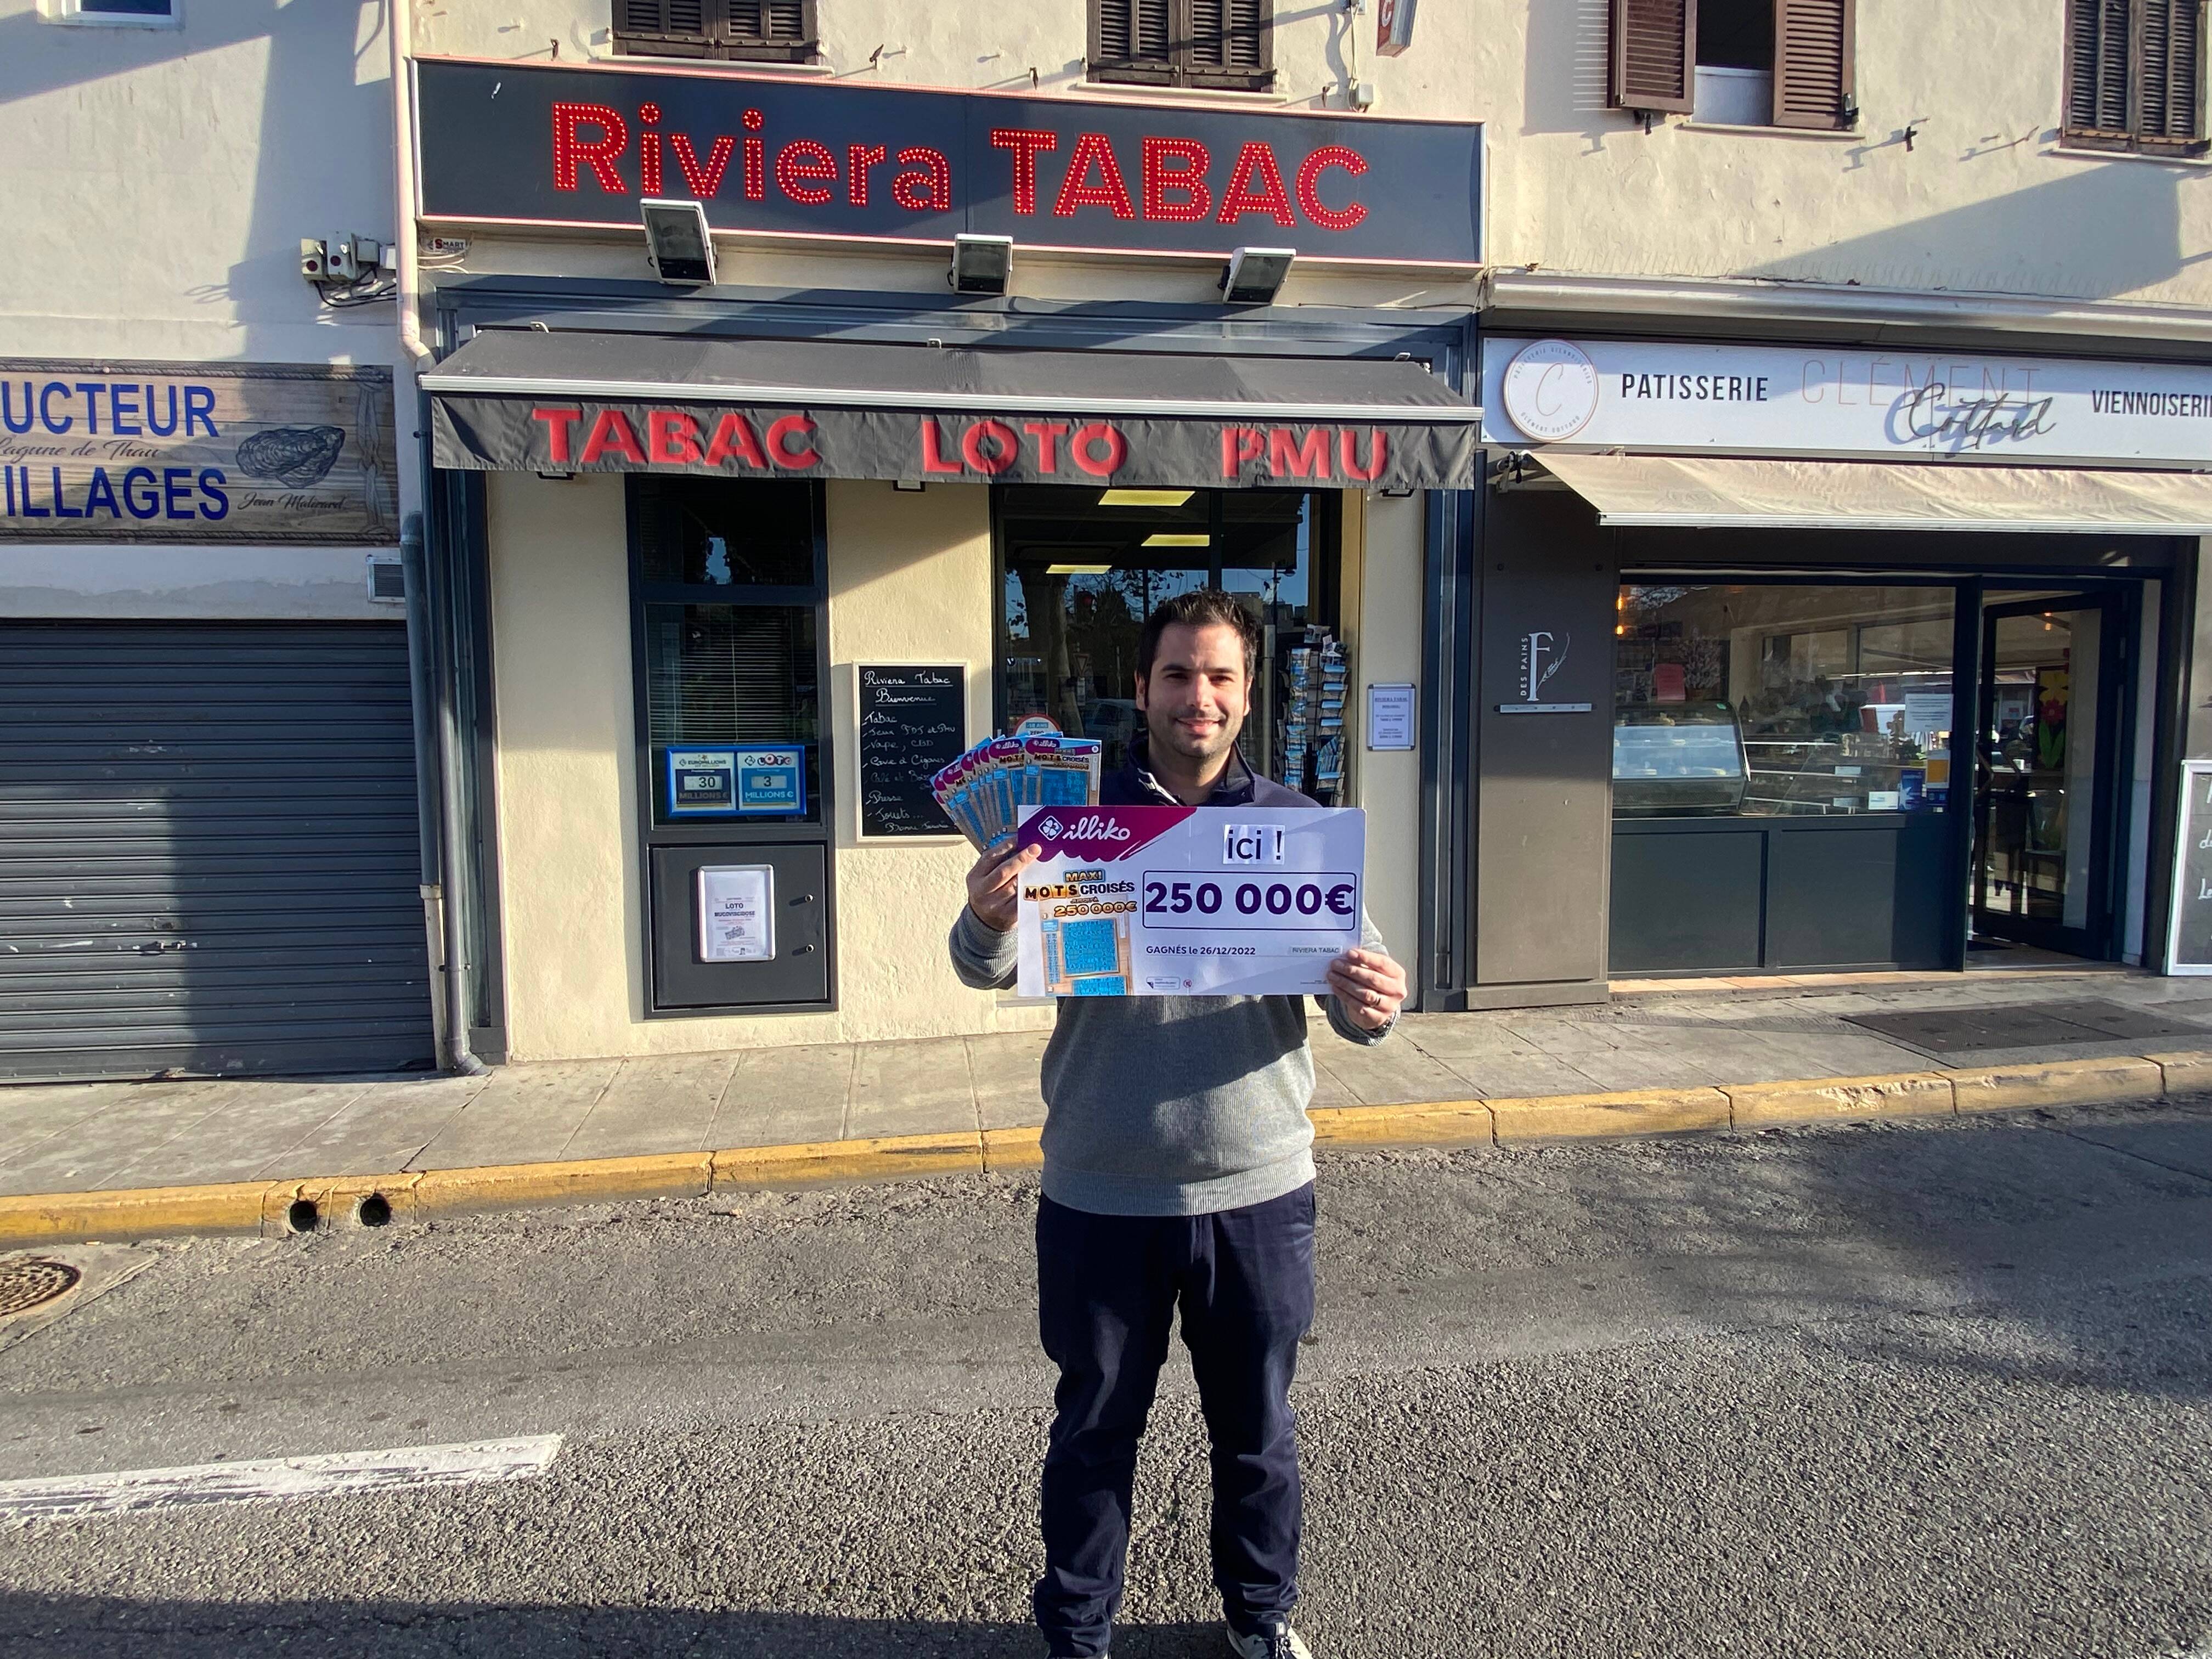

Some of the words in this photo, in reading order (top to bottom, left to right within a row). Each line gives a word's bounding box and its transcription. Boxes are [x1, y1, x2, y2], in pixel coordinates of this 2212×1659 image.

[551, 101, 951, 212] Riviera
[991, 129, 1370, 232] TABAC
[1621, 373, 1769, 402] PATISSERIE
[1801, 355, 2041, 410] CLÉMENT
[2, 380, 219, 437] UCTEUR
[70, 440, 97, 456] de
[103, 439, 159, 460] Thau
[532, 408, 819, 470] TABAC
[922, 419, 1125, 476] LOTO
[1221, 427, 1388, 481] PMU
[4, 465, 229, 521] ILLAGES
[238, 492, 274, 510] Jean
[1521, 637, 1529, 670] PAINS
[915, 670, 951, 684] Tabac
[875, 687, 936, 703] Bienvenue
[865, 711, 898, 723] Tabac
[870, 757, 897, 766] Cave
[698, 776, 716, 788] 30
[763, 776, 772, 787] 3
[868, 790, 904, 804] Presse
[1062, 815, 1131, 841] illiko
[1227, 830, 1261, 861] ici
[1065, 869, 1102, 882] MAXI
[1025, 884, 1078, 899] MOTS
[1080, 880, 1136, 895] CROISÉS
[1145, 882, 1223, 915] 250
[1235, 883, 1356, 915] 000€
[1054, 904, 1089, 917] 250
[1146, 944, 1187, 955] GAGNÉS
[1188, 947, 1199, 955] le
[1200, 946, 1256, 956] 26/12/2022
